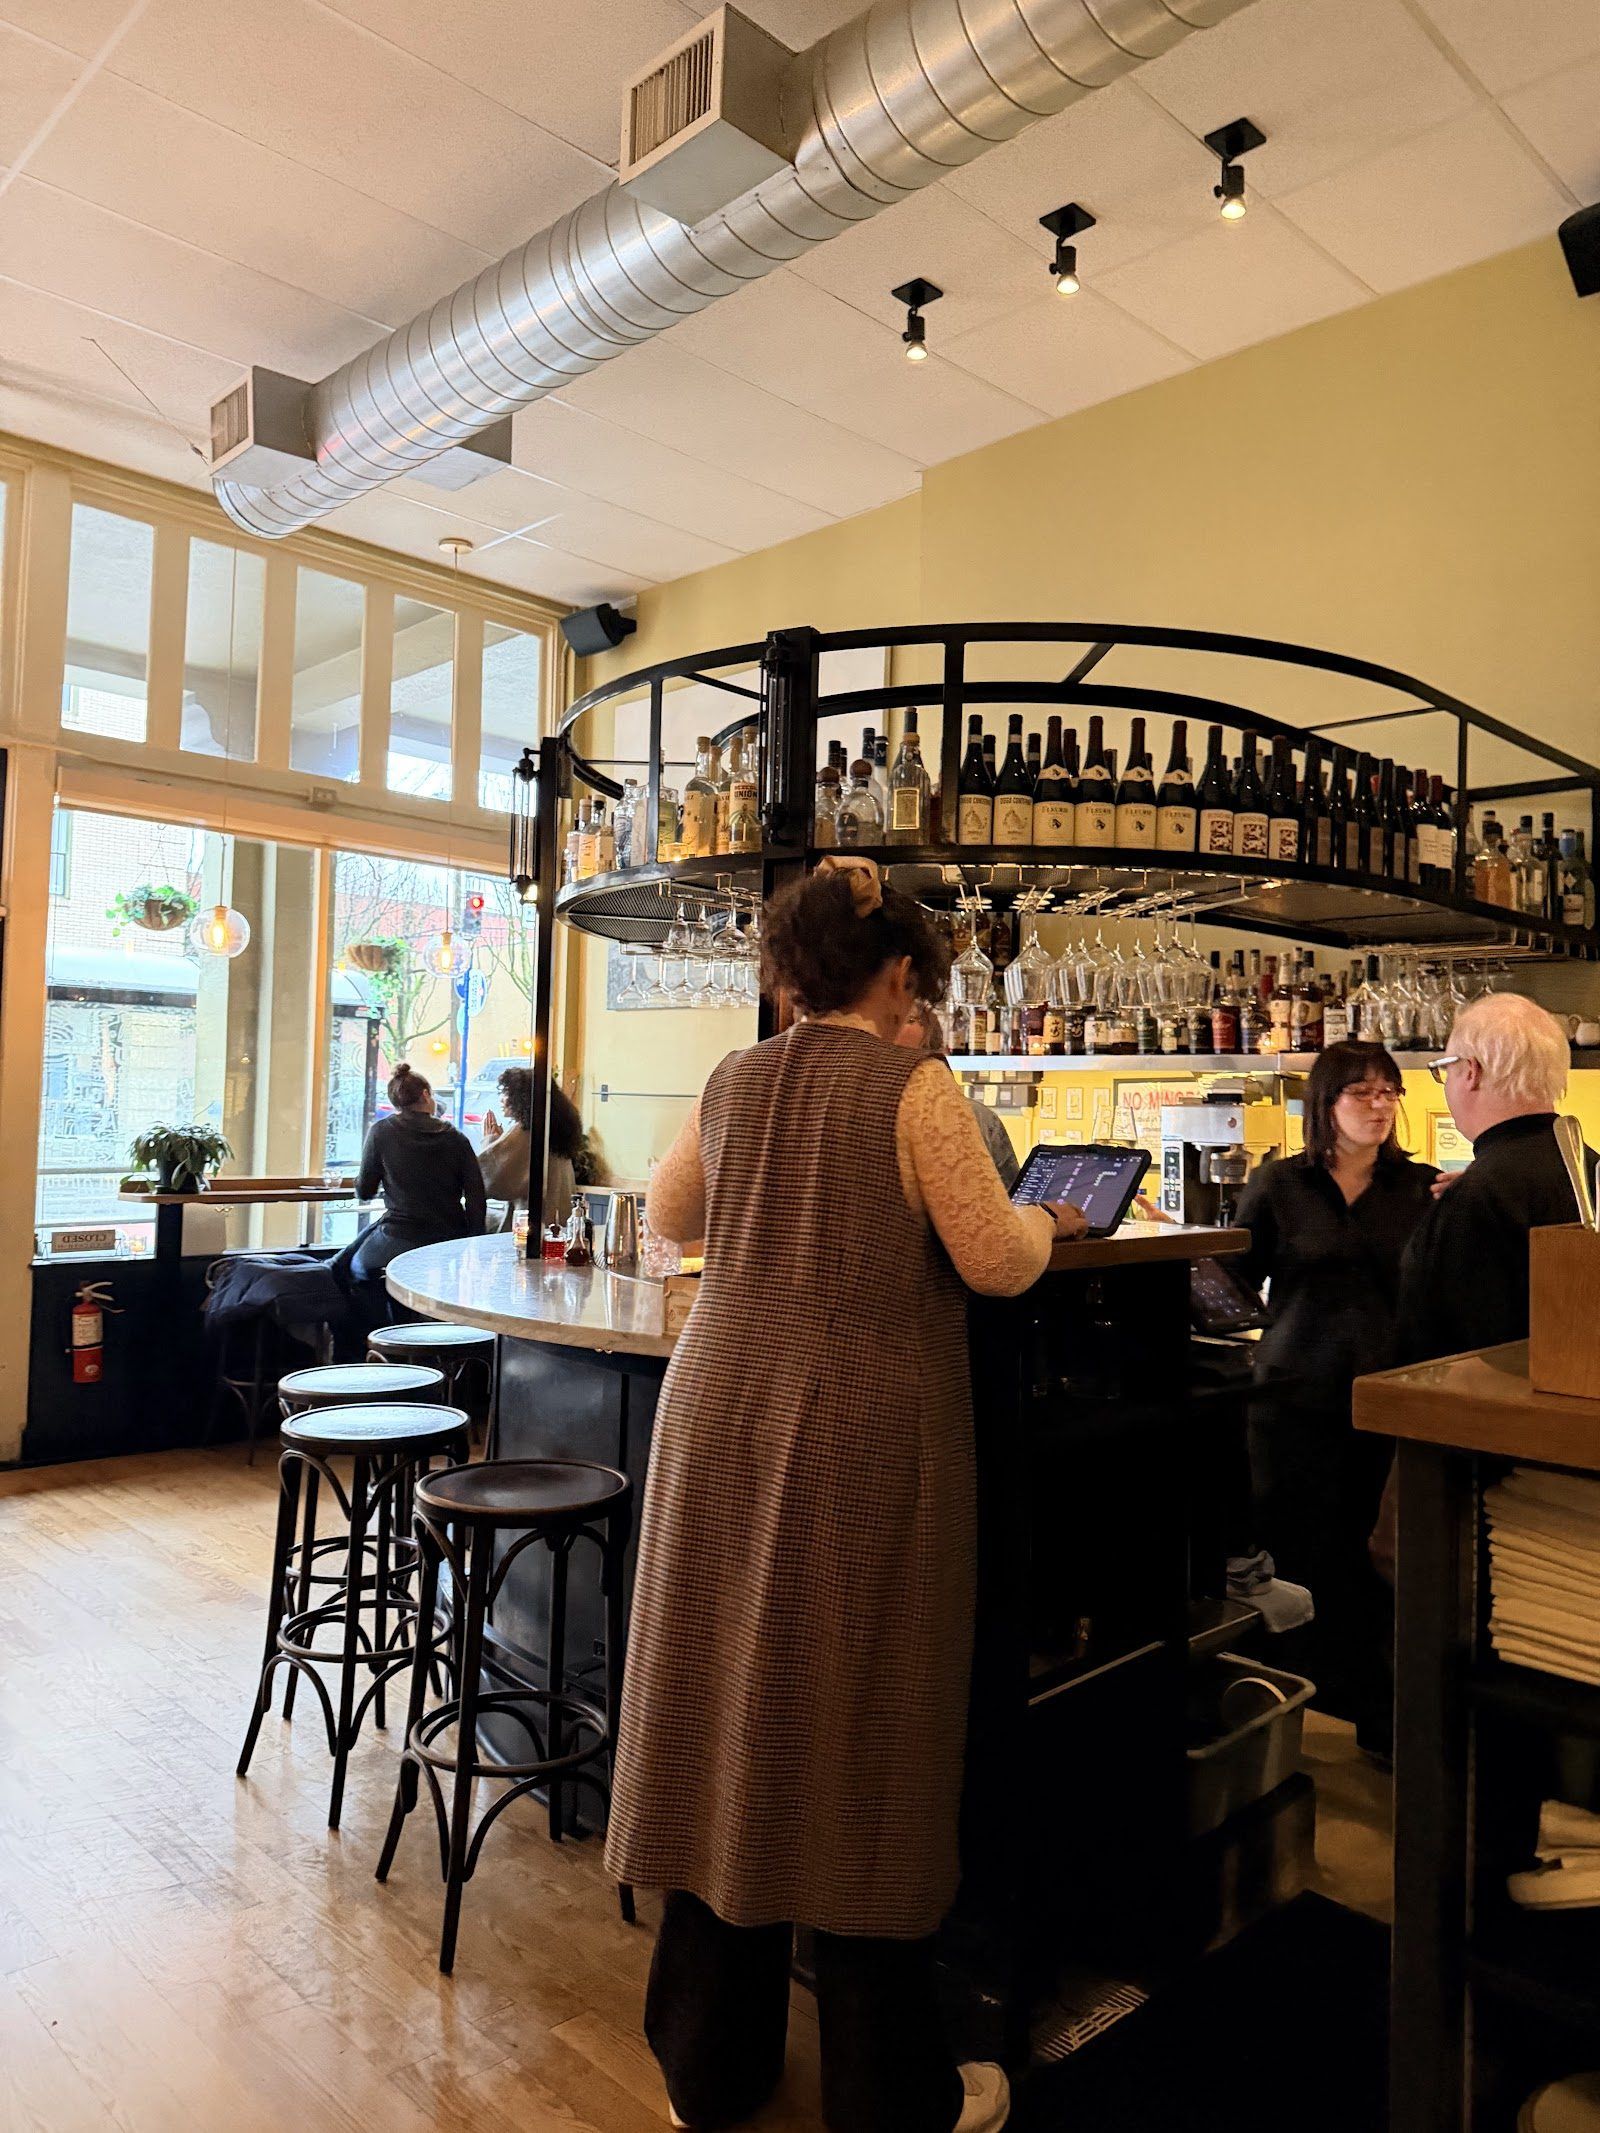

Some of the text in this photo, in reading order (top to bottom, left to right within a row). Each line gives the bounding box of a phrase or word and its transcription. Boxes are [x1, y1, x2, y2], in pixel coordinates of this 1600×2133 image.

[734, 790, 758, 798] UNION
[1123, 1092, 1142, 1110] NO
[62, 1234, 106, 1243] CLOSED
